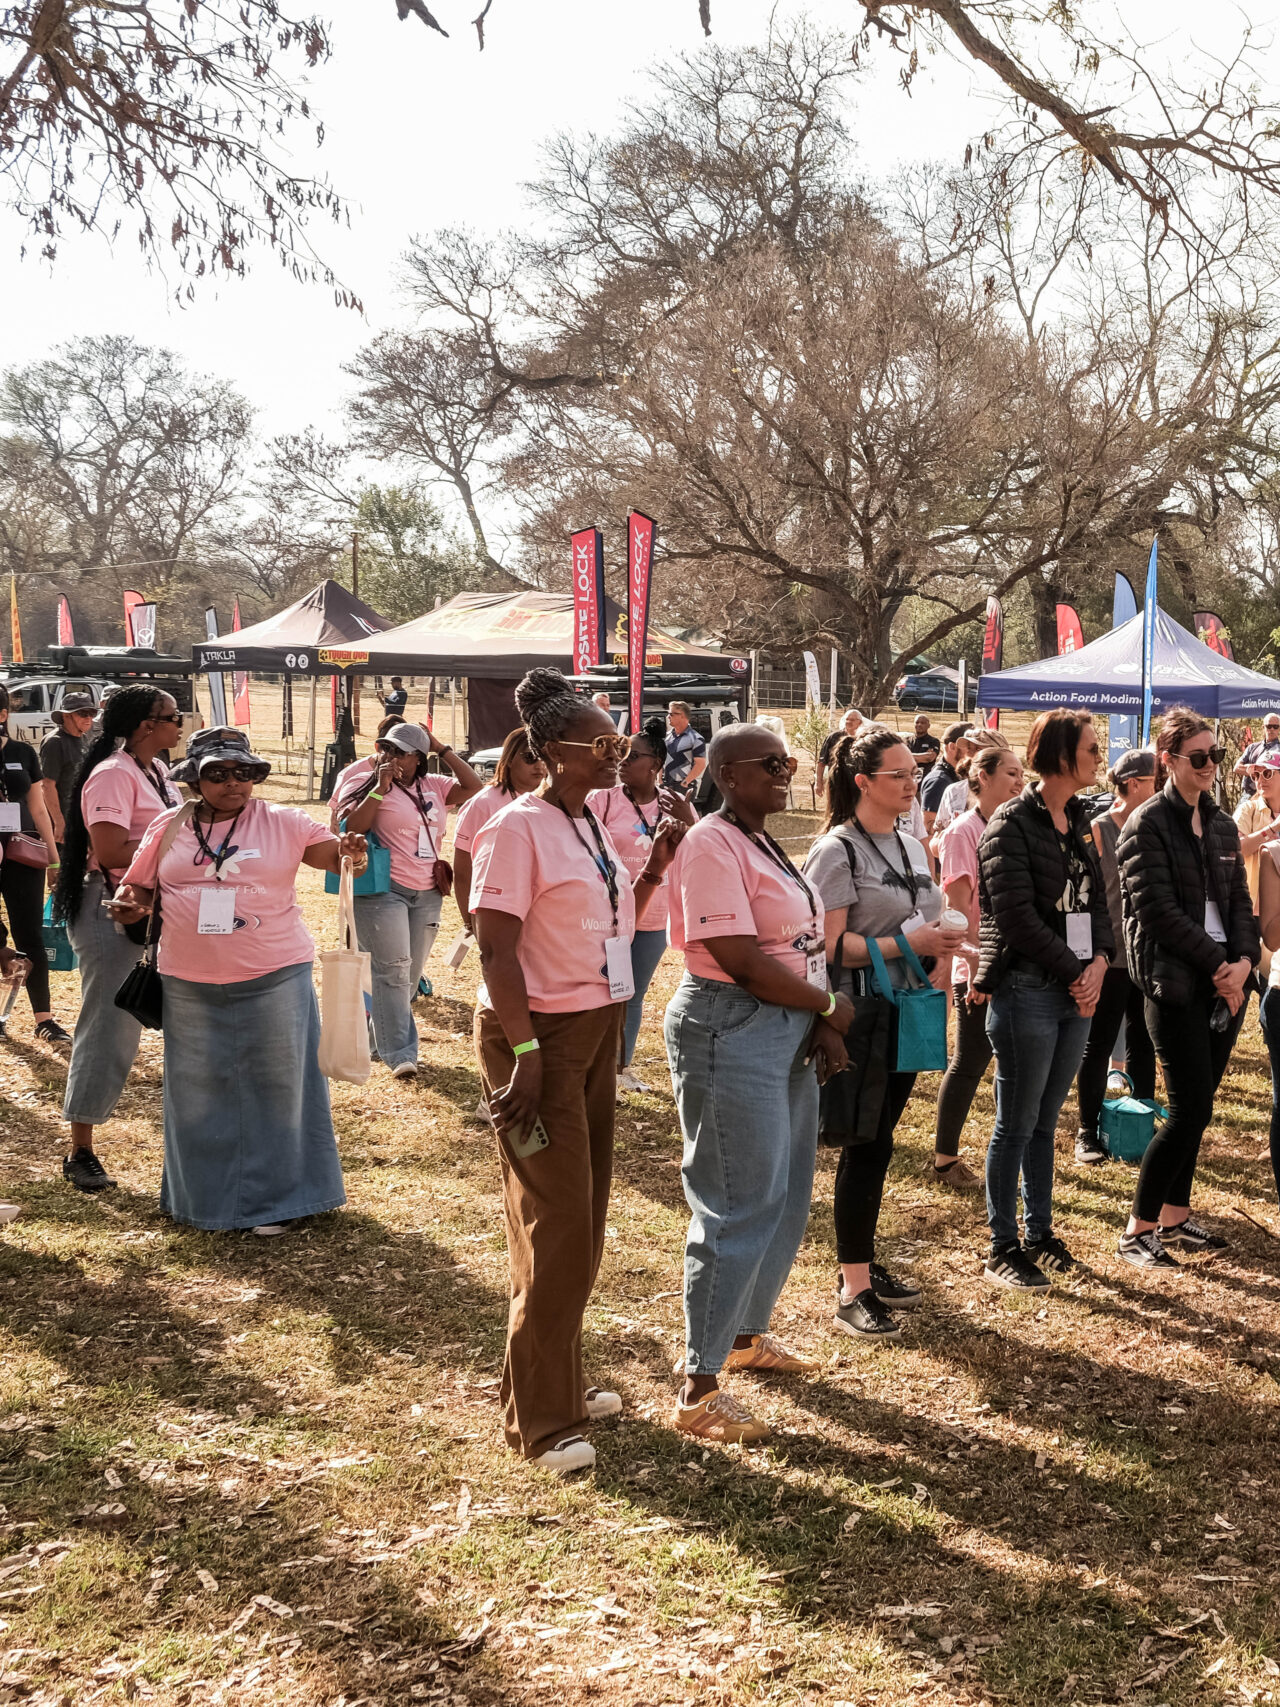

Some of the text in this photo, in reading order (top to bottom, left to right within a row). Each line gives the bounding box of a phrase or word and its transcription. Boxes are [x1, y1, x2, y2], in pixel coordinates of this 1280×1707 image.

[633, 525, 645, 600] LOCK
[577, 544, 591, 675] OSITE LOCK
[205, 650, 236, 661] TAKLA
[648, 655, 661, 665] DOG
[733, 658, 745, 670] OL
[1030, 691, 1161, 706] Action Ford Modimle
[581, 917, 613, 930] Wome
[810, 960, 818, 973] 12
